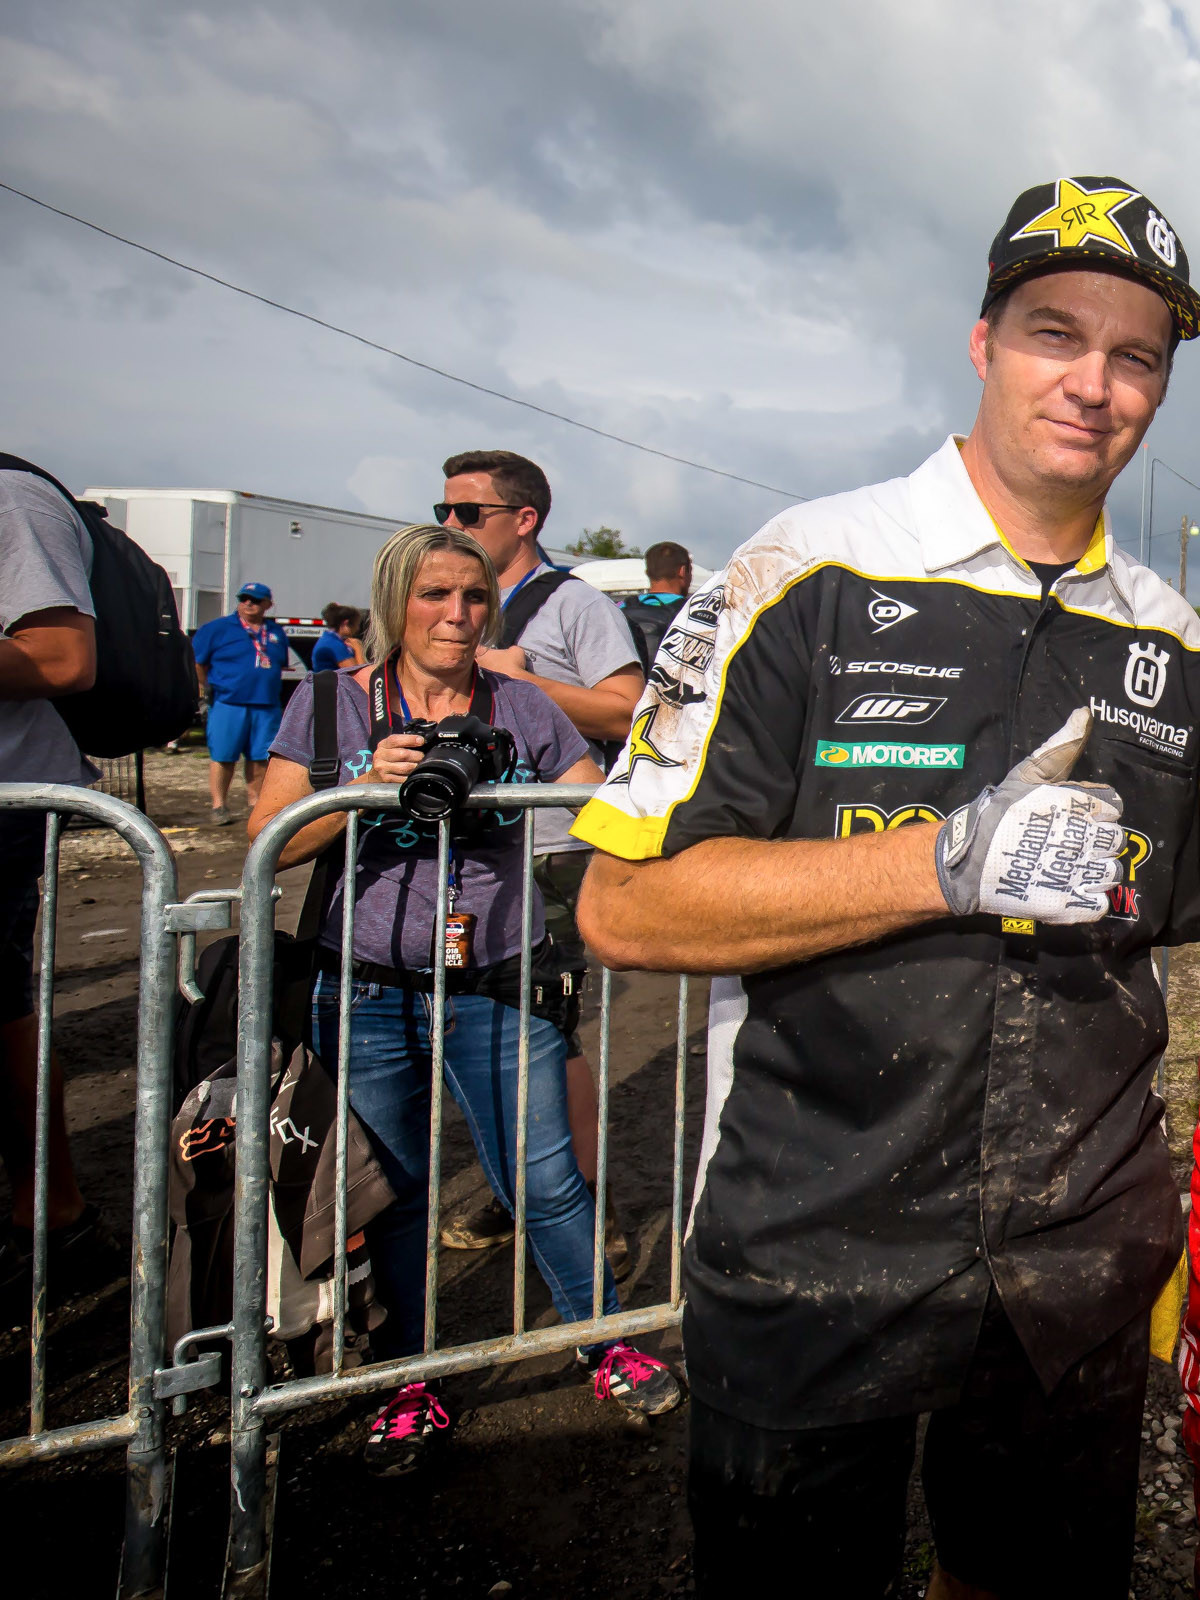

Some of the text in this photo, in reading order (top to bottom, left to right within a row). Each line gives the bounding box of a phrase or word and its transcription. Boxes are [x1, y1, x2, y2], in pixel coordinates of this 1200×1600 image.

[845, 661, 963, 678] SCOSCHE
[374, 677, 385, 721] Canon
[851, 698, 930, 718] WP
[1090, 696, 1188, 746] Husqvarna
[852, 745, 959, 766] MOTOREX
[1159, 744, 1184, 758] RACING
[995, 811, 1053, 901] Mechanix
[1036, 797, 1092, 892] Mechanix
